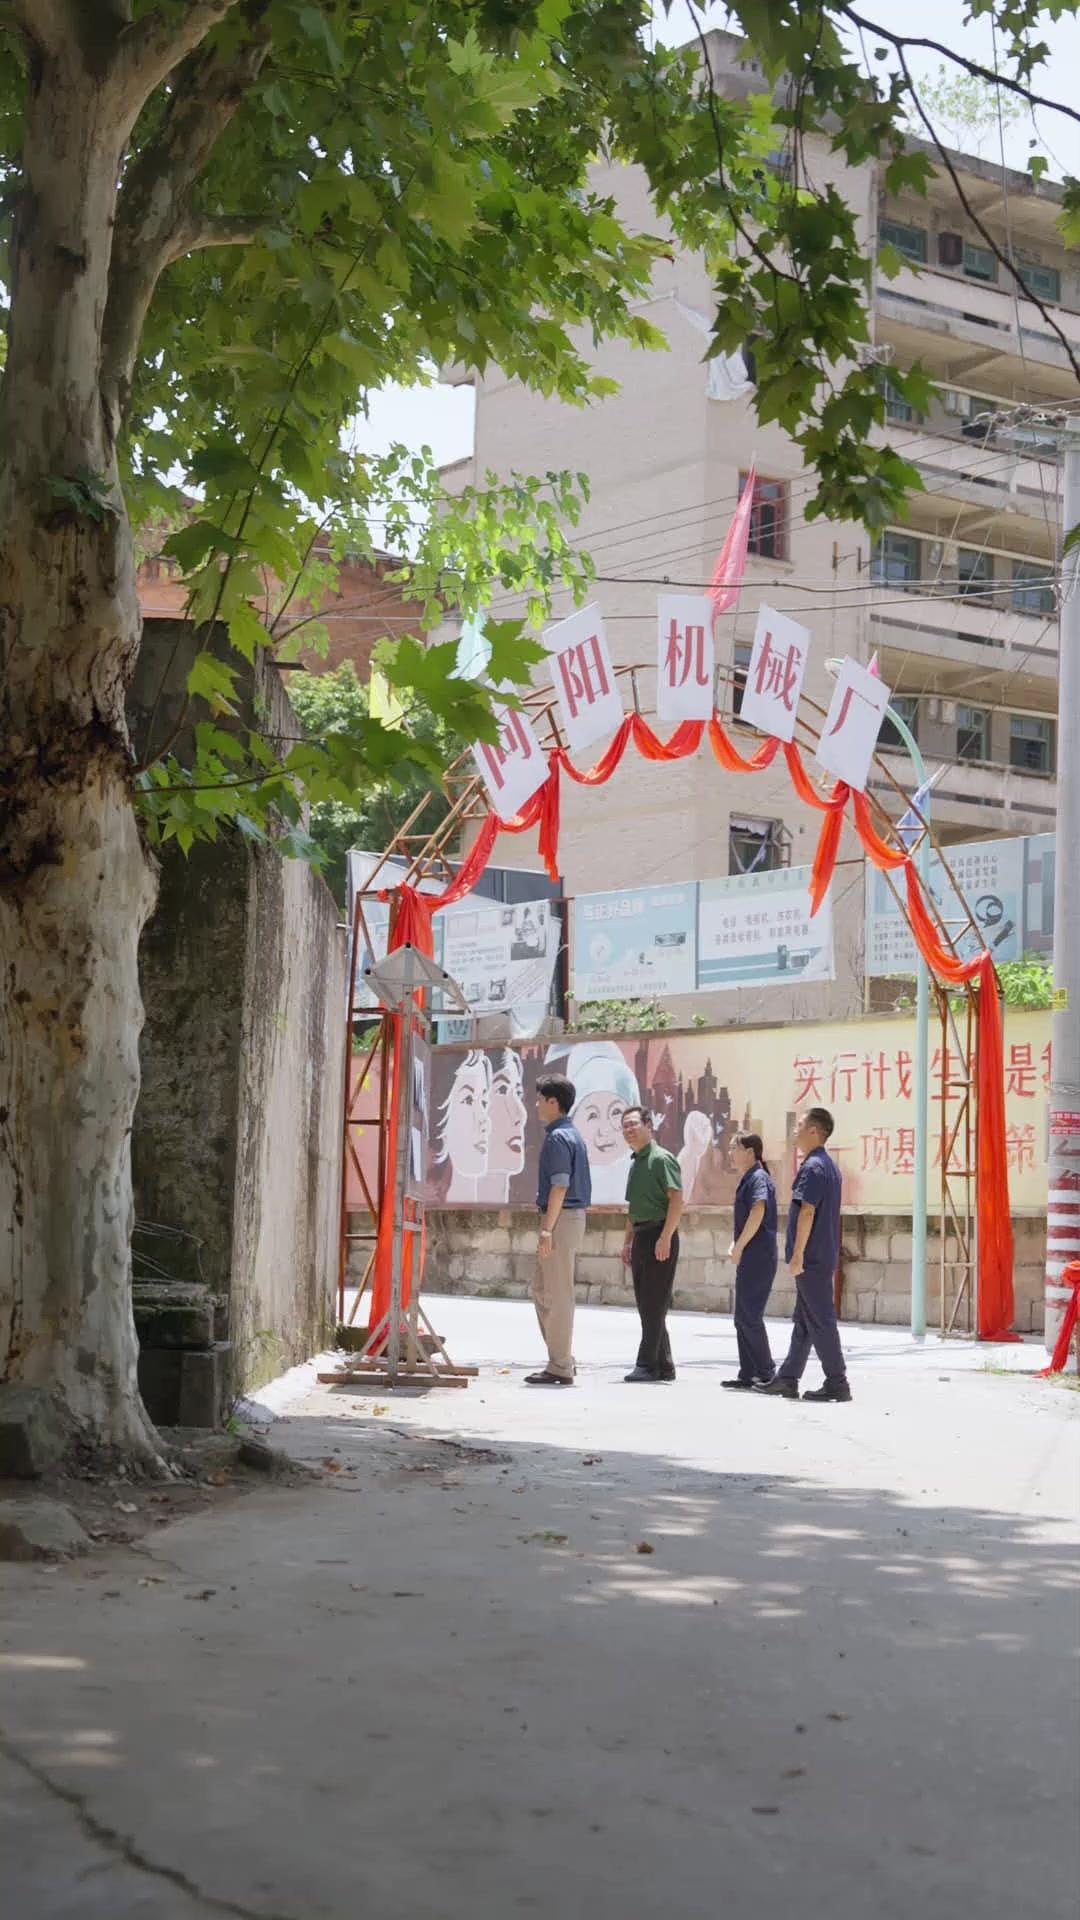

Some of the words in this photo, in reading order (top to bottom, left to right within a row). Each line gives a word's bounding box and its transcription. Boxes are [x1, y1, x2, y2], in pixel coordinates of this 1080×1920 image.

[793, 1040, 1052, 1104] 实行计划生是
